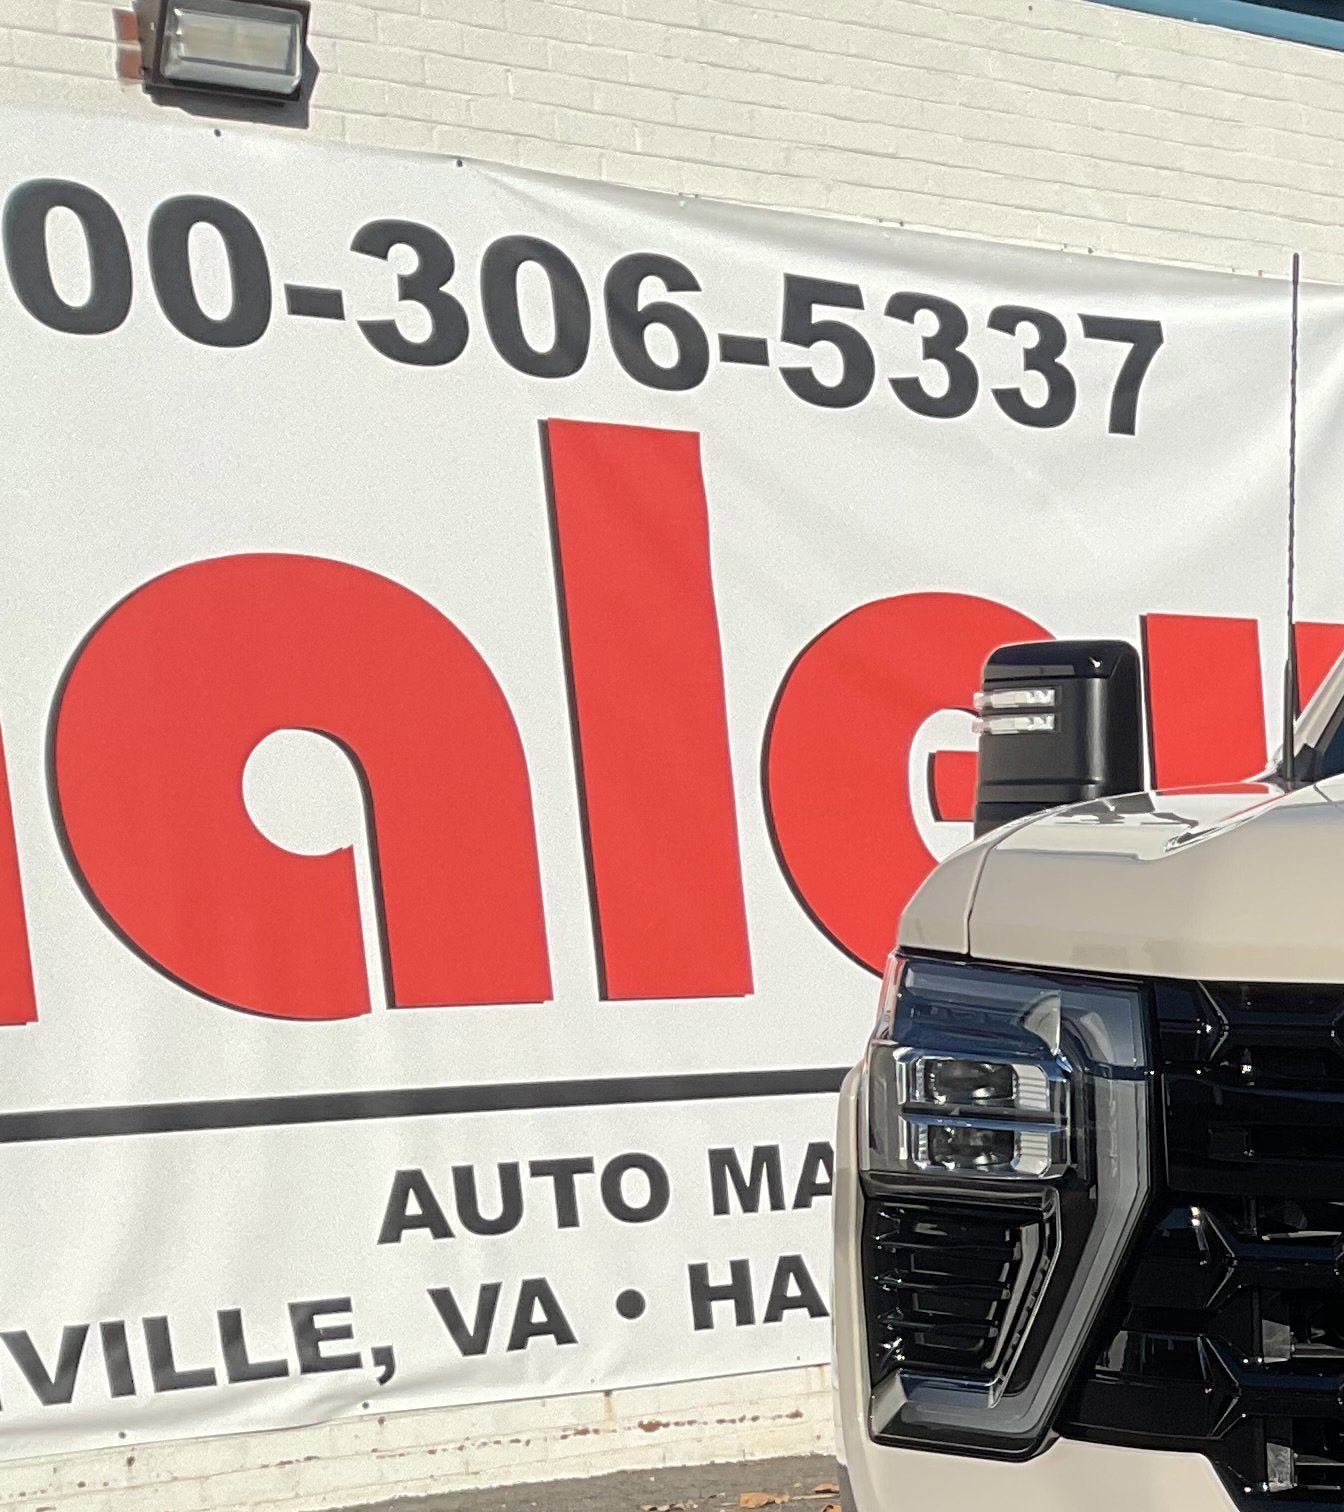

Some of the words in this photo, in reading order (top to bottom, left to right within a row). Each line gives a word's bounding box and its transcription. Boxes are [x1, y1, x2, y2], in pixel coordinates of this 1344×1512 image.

[377, 1152, 670, 1245] AUTO
[2, 1296, 397, 1406] VILLE,
[428, 1277, 579, 1357] VA
